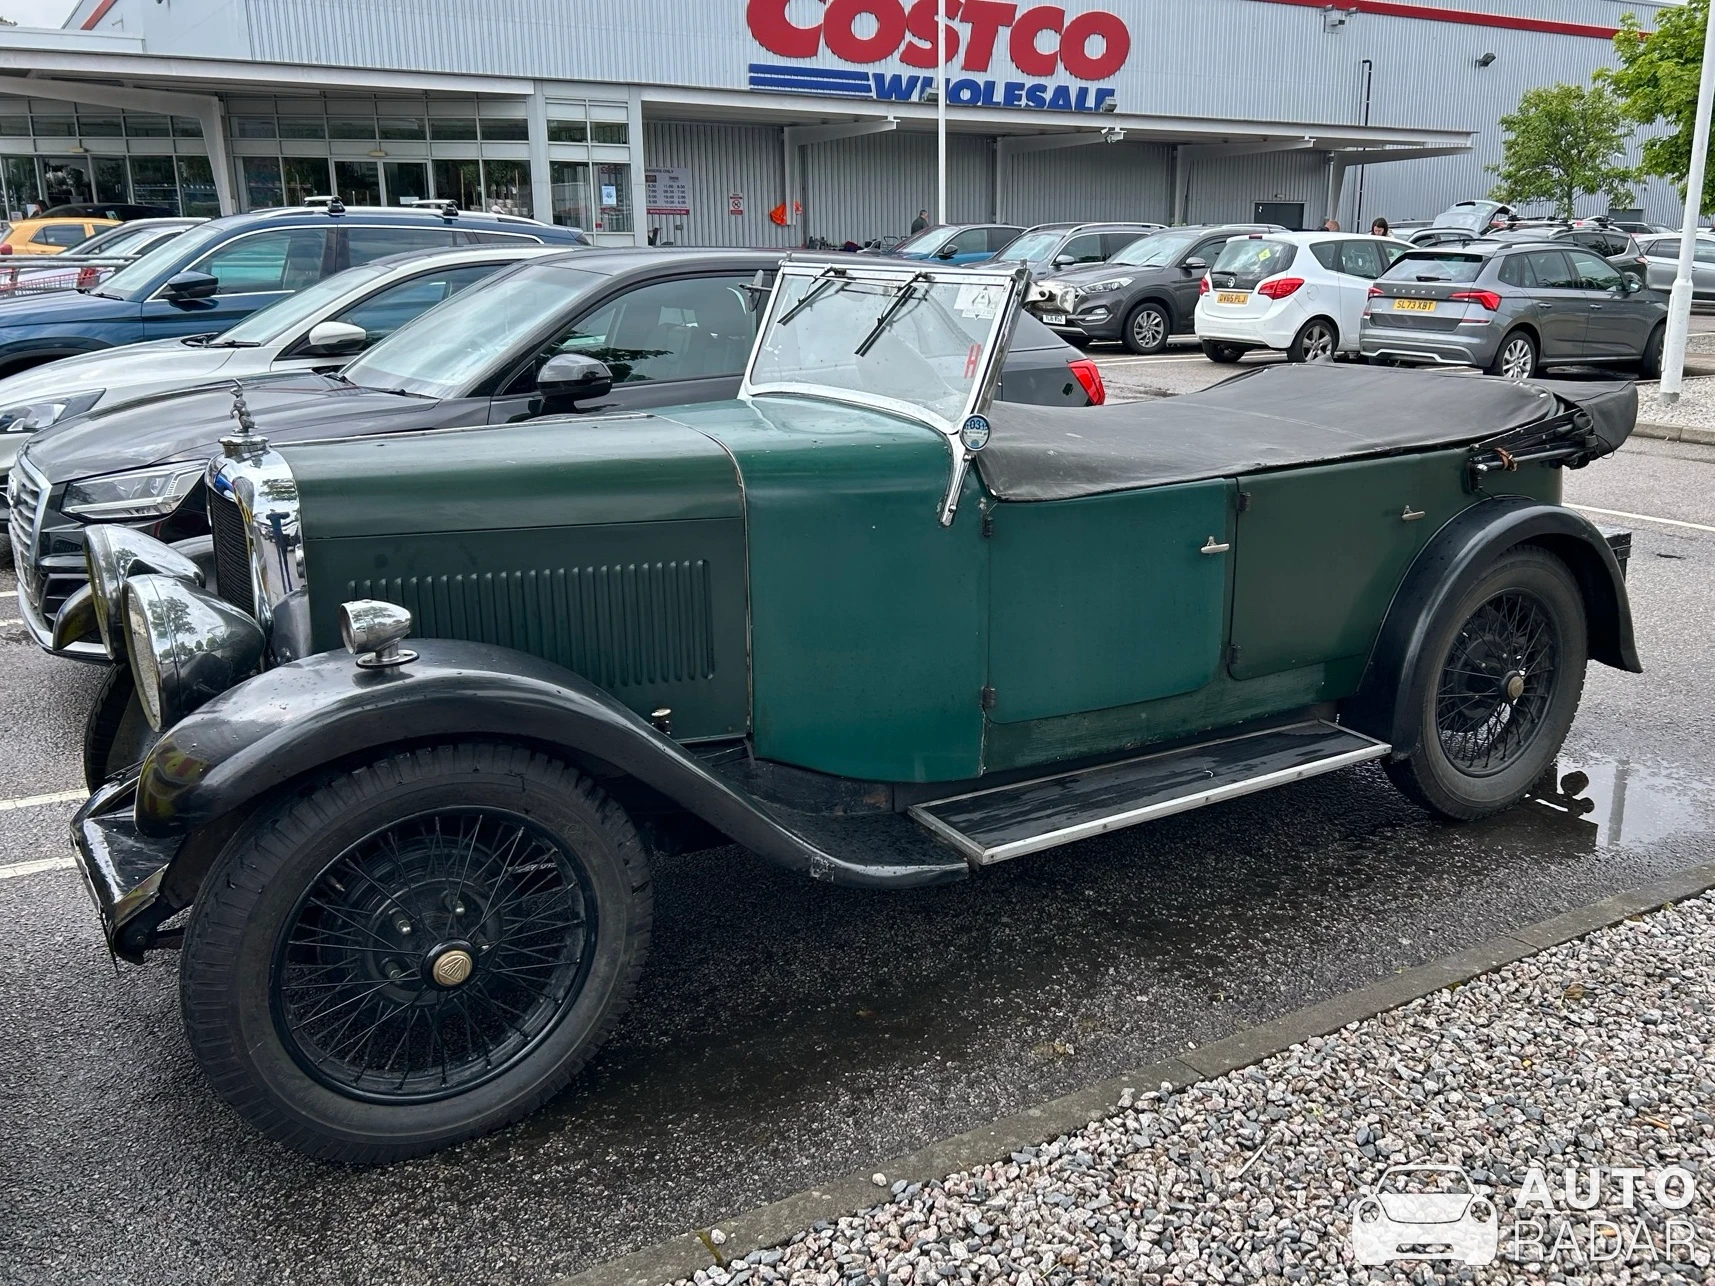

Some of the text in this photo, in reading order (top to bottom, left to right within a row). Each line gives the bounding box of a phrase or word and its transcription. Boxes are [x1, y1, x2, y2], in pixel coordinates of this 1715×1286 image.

[747, 0, 1130, 81] COSTCO
[1397, 300, 1433, 310] SL73 XBT
[970, 419, 981, 430] 03
